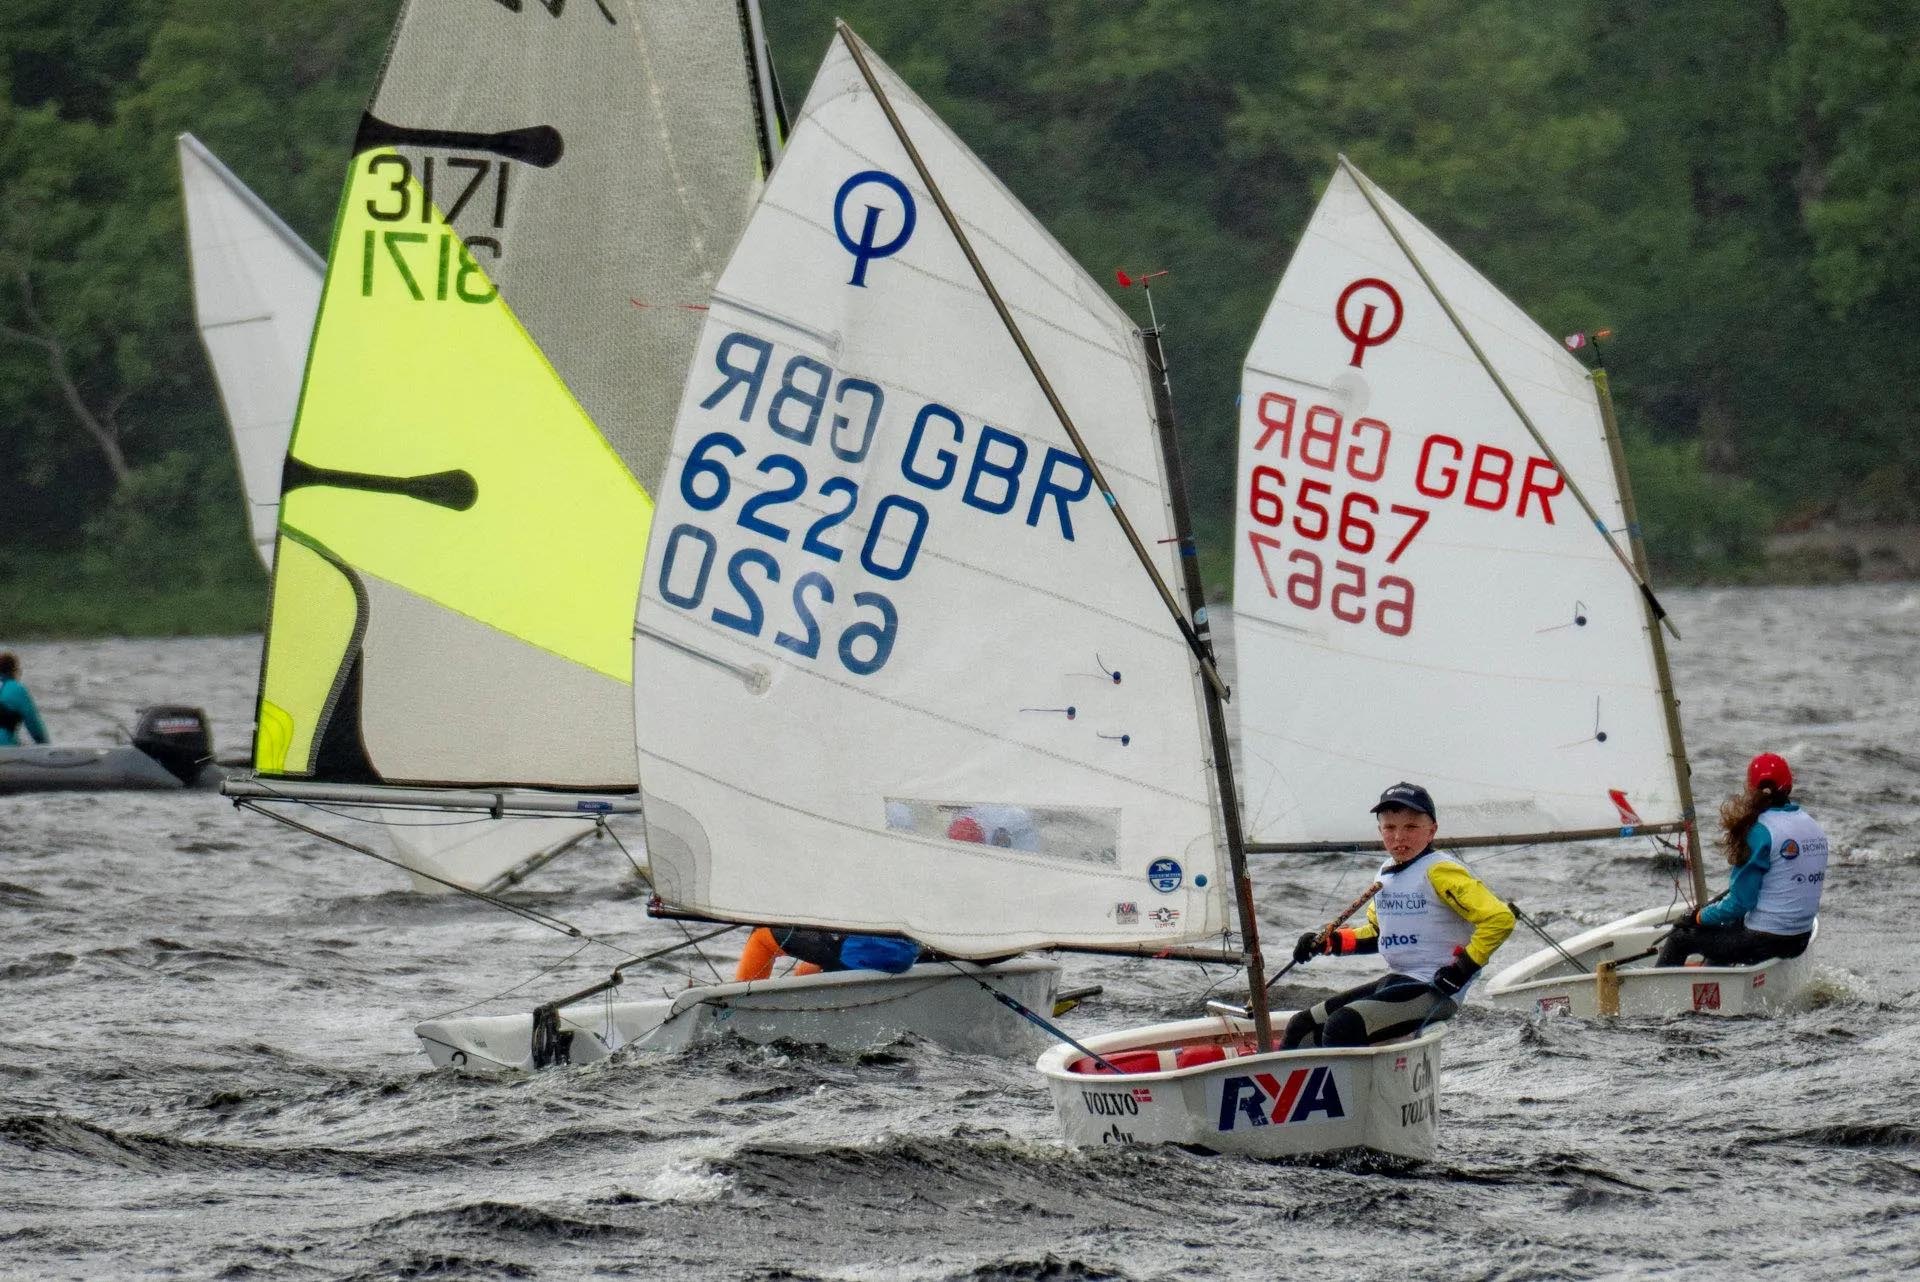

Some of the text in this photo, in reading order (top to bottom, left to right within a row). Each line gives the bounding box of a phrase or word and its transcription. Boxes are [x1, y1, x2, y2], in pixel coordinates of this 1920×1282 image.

[366, 154, 510, 228] 3171
[680, 431, 929, 581] 6220
[900, 403, 1093, 542] GBR
[1415, 434, 1565, 525] GBR
[1250, 465, 1430, 564] 6567
[1406, 899, 1426, 909] CUP
[1808, 871, 1825, 884] opto
[1380, 933, 1418, 949] optos
[1082, 1091, 1138, 1115] VOLVO
[1219, 1066, 1345, 1130] RYA
